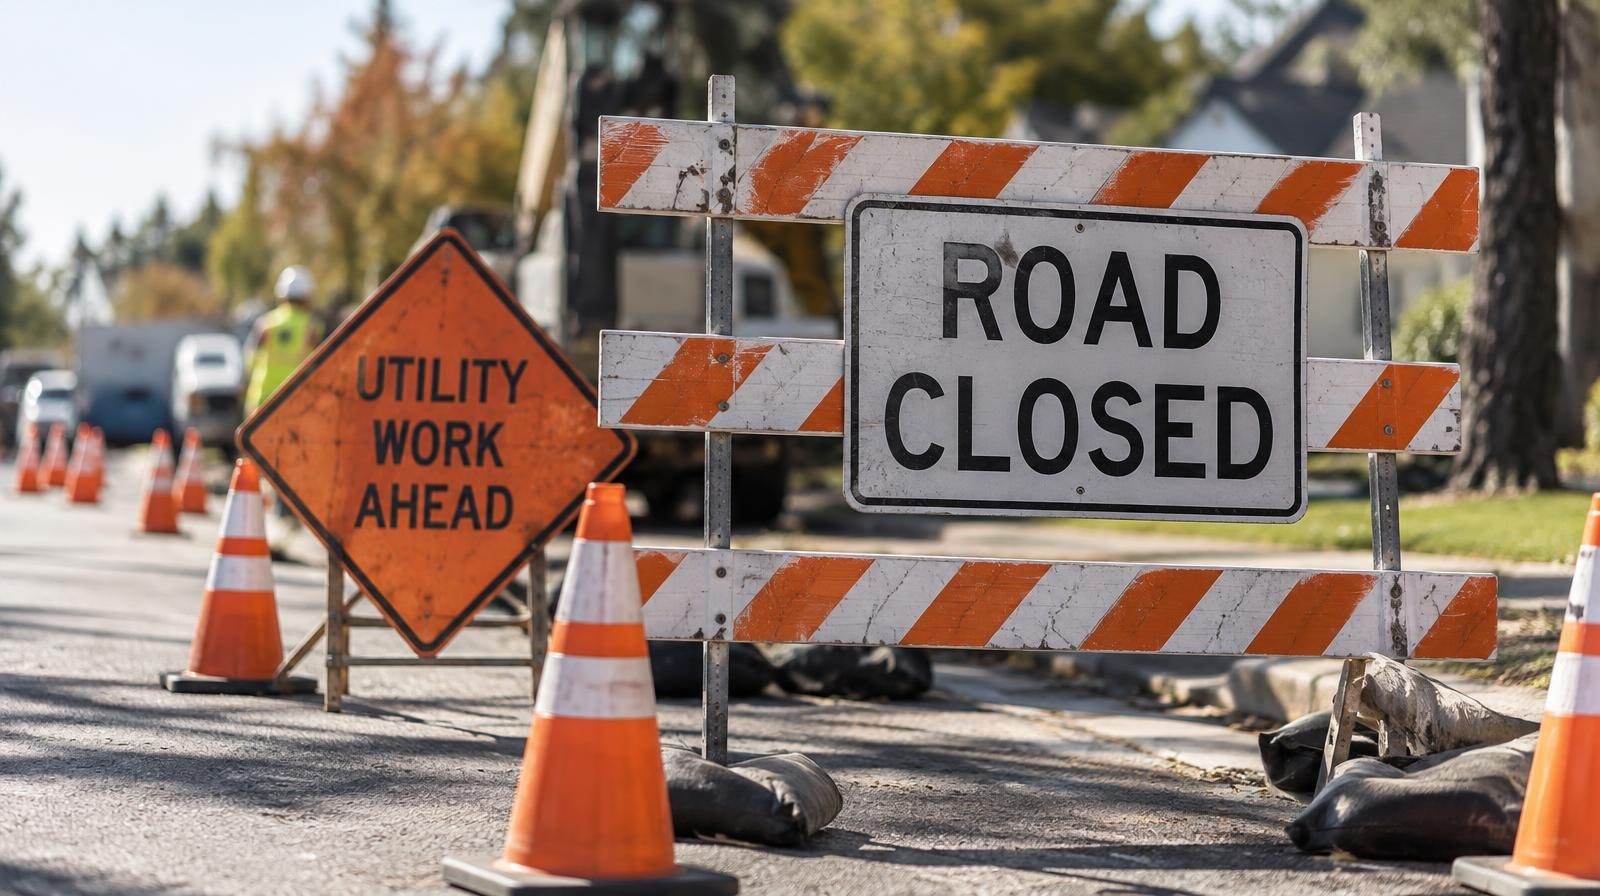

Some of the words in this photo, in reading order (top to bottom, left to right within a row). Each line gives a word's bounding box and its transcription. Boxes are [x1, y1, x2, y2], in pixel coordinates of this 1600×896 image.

[942, 241, 1221, 349] ROAD
[357, 356, 528, 404] UTILITY
[373, 420, 504, 468] WORK
[884, 371, 1274, 481] CLOSED
[354, 483, 514, 531] AHEAD
